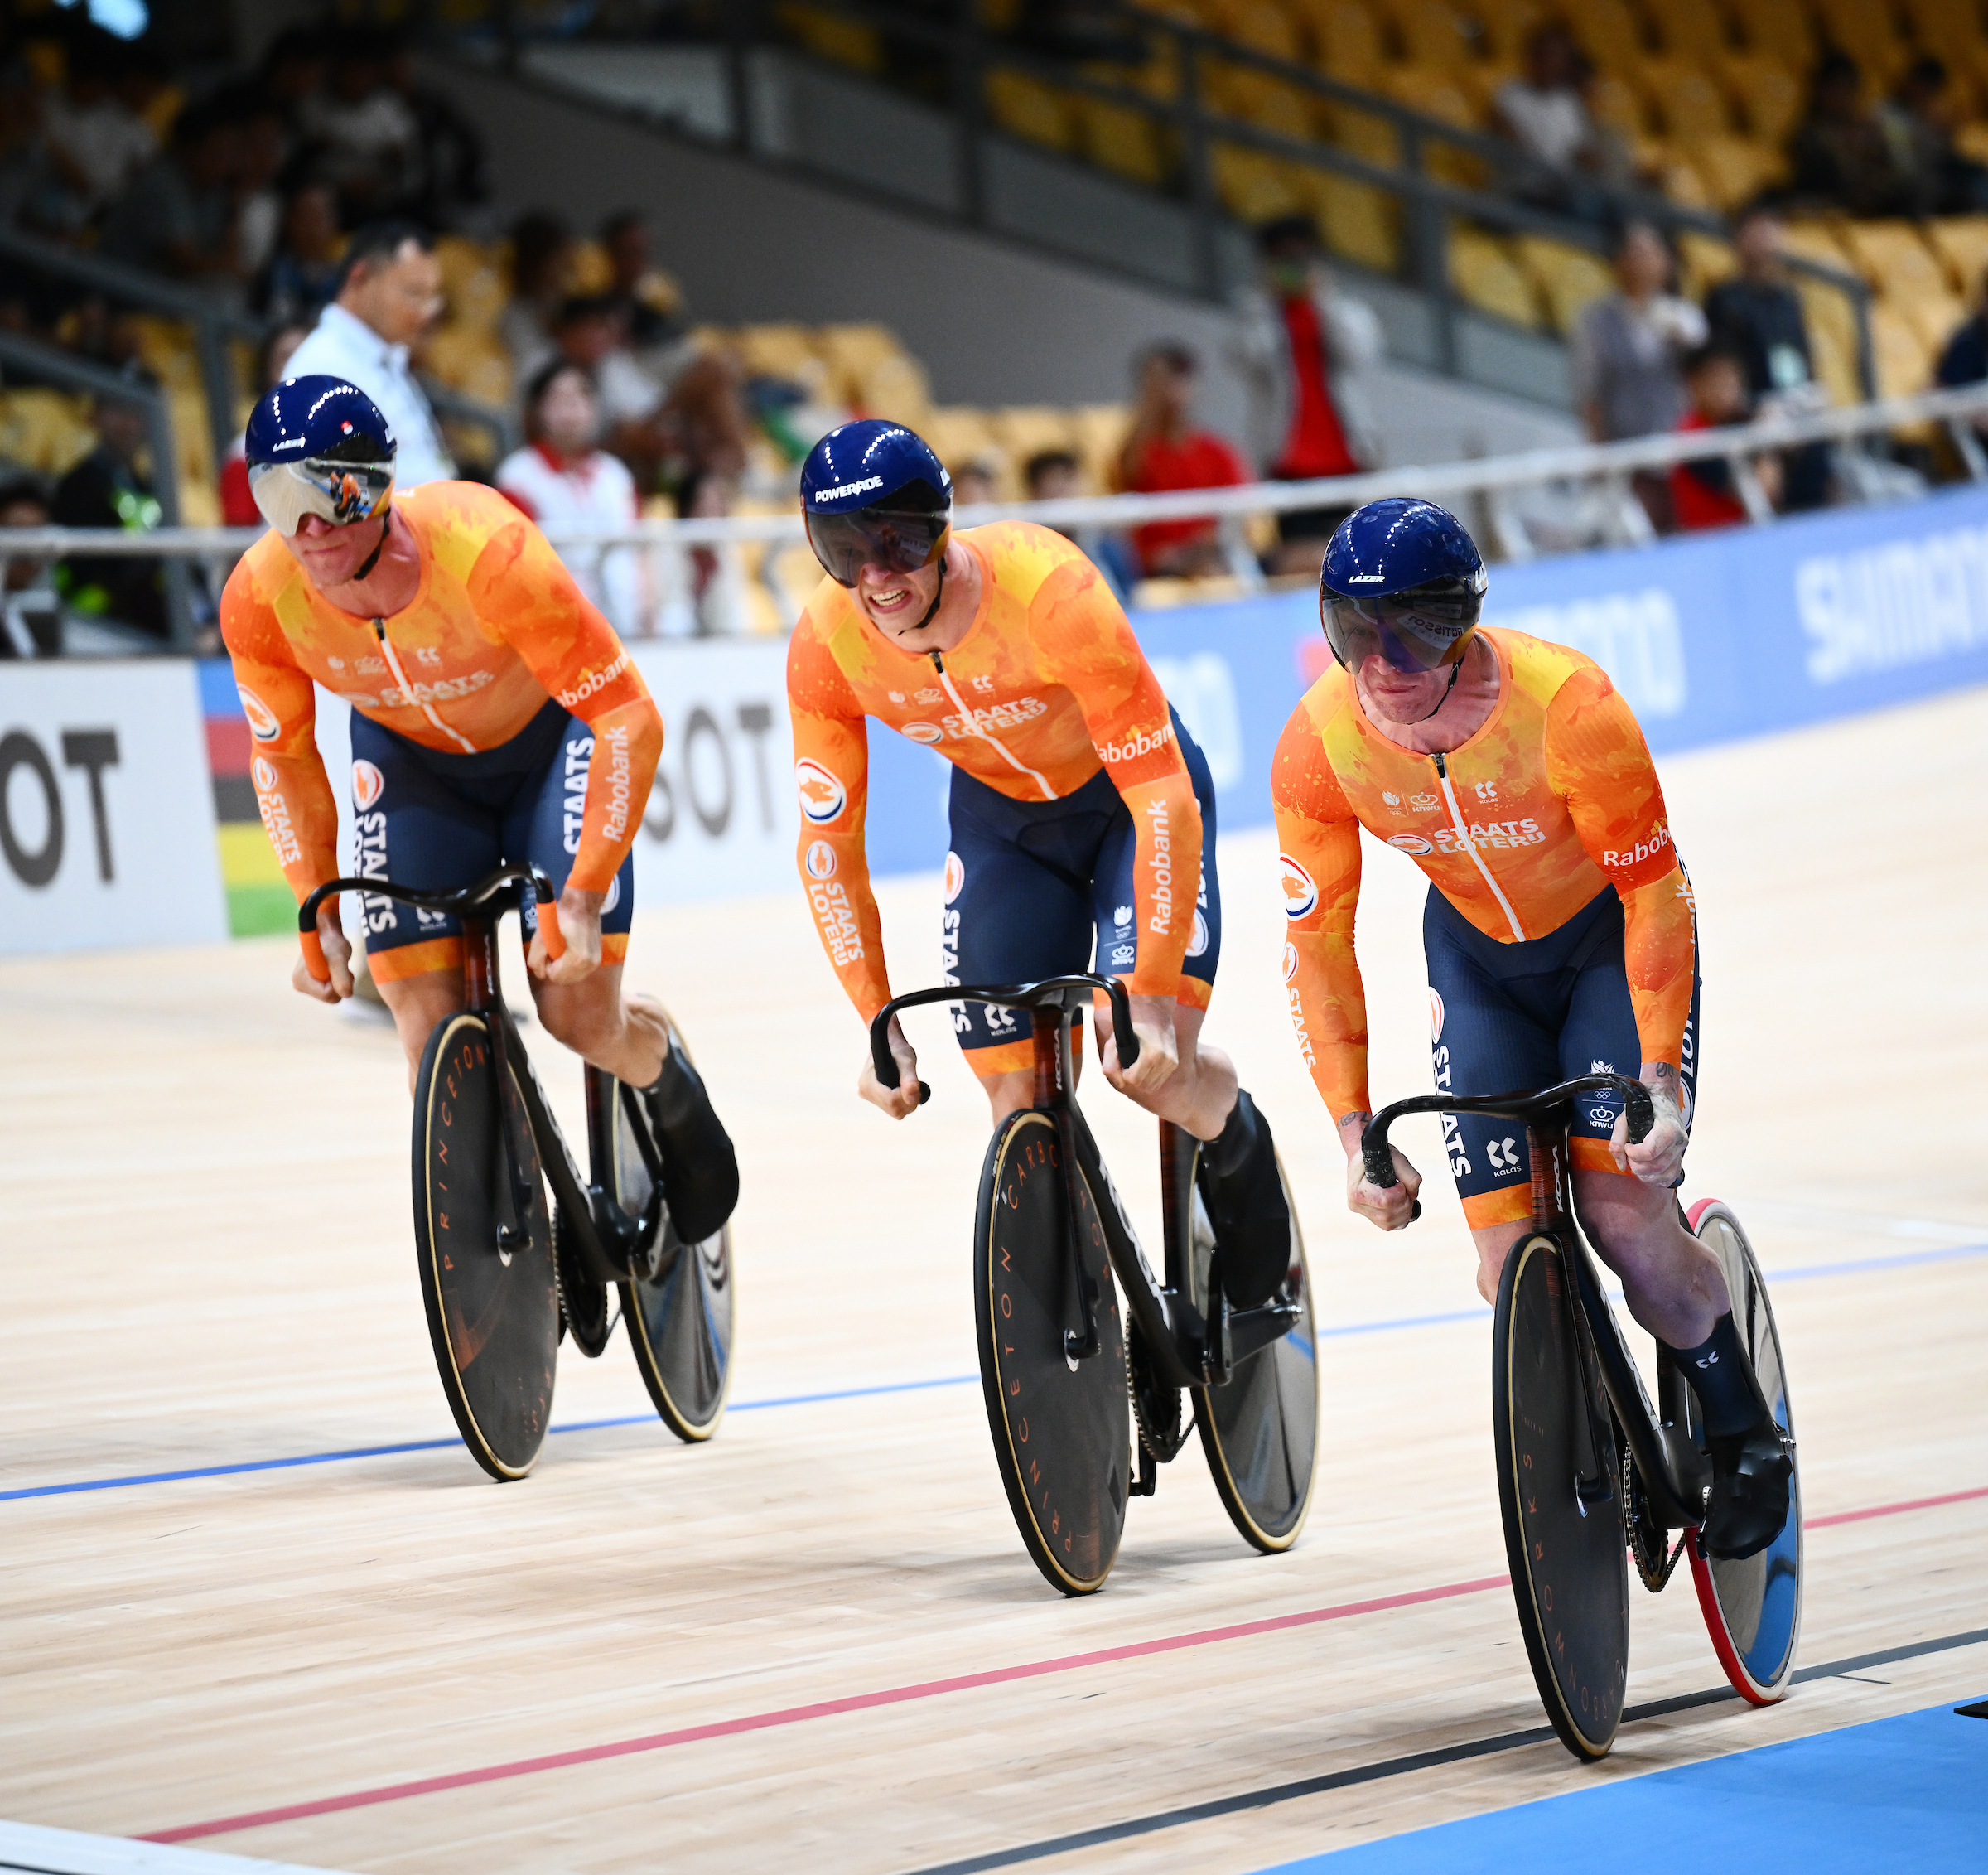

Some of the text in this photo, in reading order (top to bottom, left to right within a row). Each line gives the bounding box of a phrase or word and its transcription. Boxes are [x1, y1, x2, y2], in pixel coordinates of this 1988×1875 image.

[815, 476, 884, 503] POWERADE
[1348, 575, 1386, 584] LAZER
[602, 725, 630, 843] Rabobank
[268, 793, 302, 863] STAATS
[1150, 799, 1172, 935] Rabobank
[825, 882, 865, 961] STAATS
[1287, 987, 1316, 1070] STAATS
[1552, 1145, 1564, 1213] KOGA
[1001, 1245, 1072, 1553] PRINCETON
